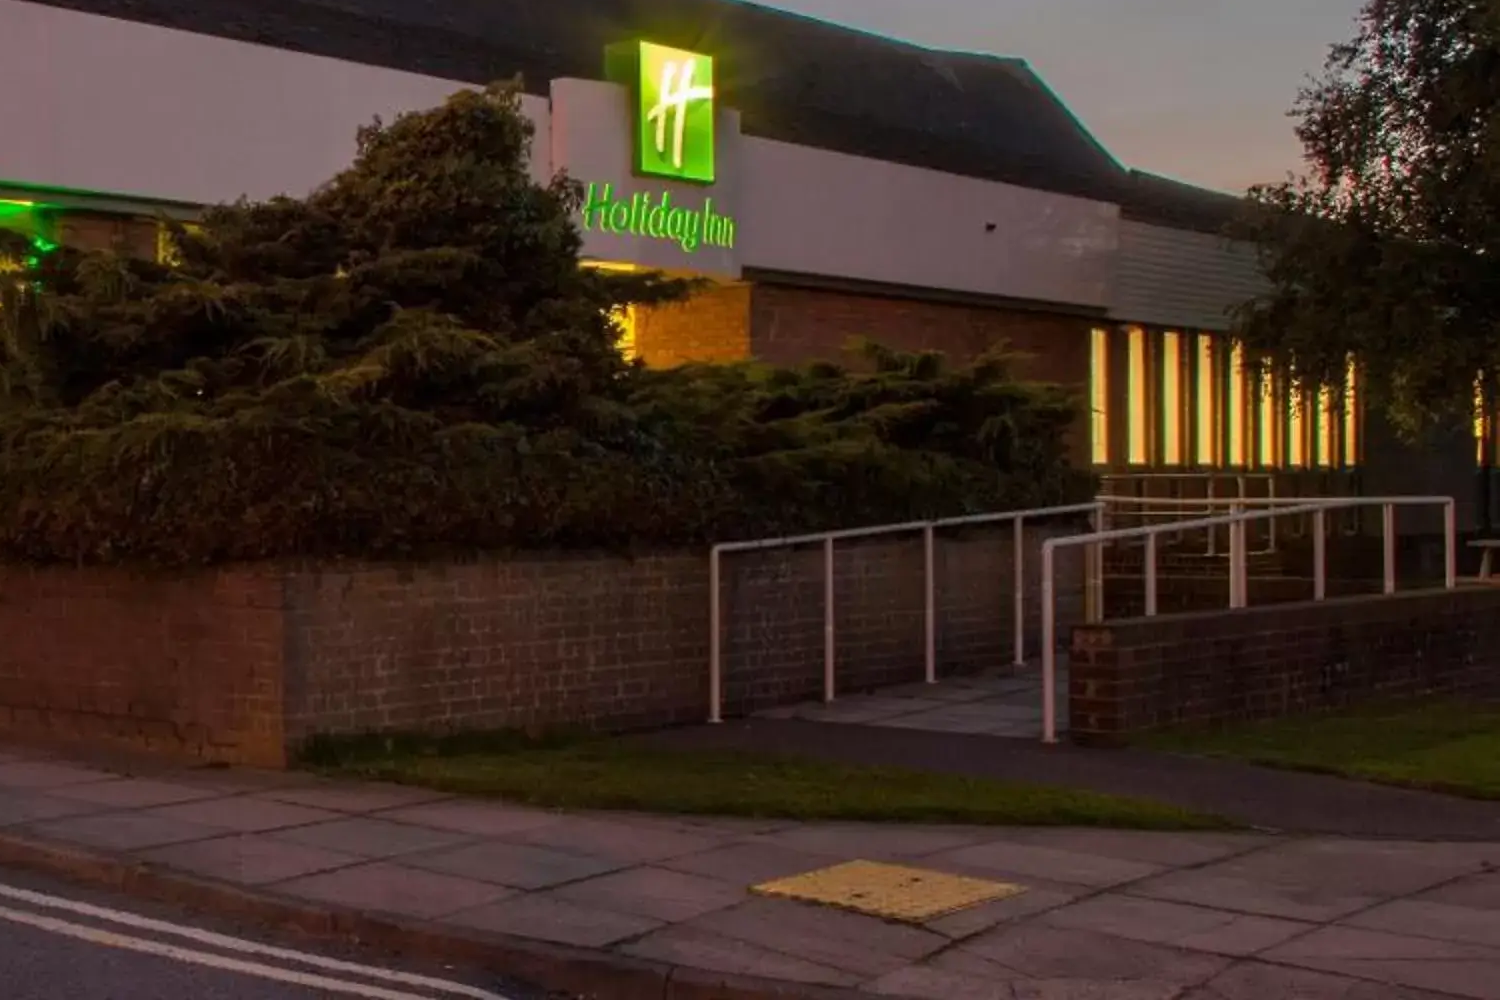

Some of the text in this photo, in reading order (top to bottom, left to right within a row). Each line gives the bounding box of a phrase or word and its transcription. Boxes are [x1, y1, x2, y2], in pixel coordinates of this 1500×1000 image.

[647, 58, 714, 168] H
[582, 183, 734, 253] Holiday Inn
